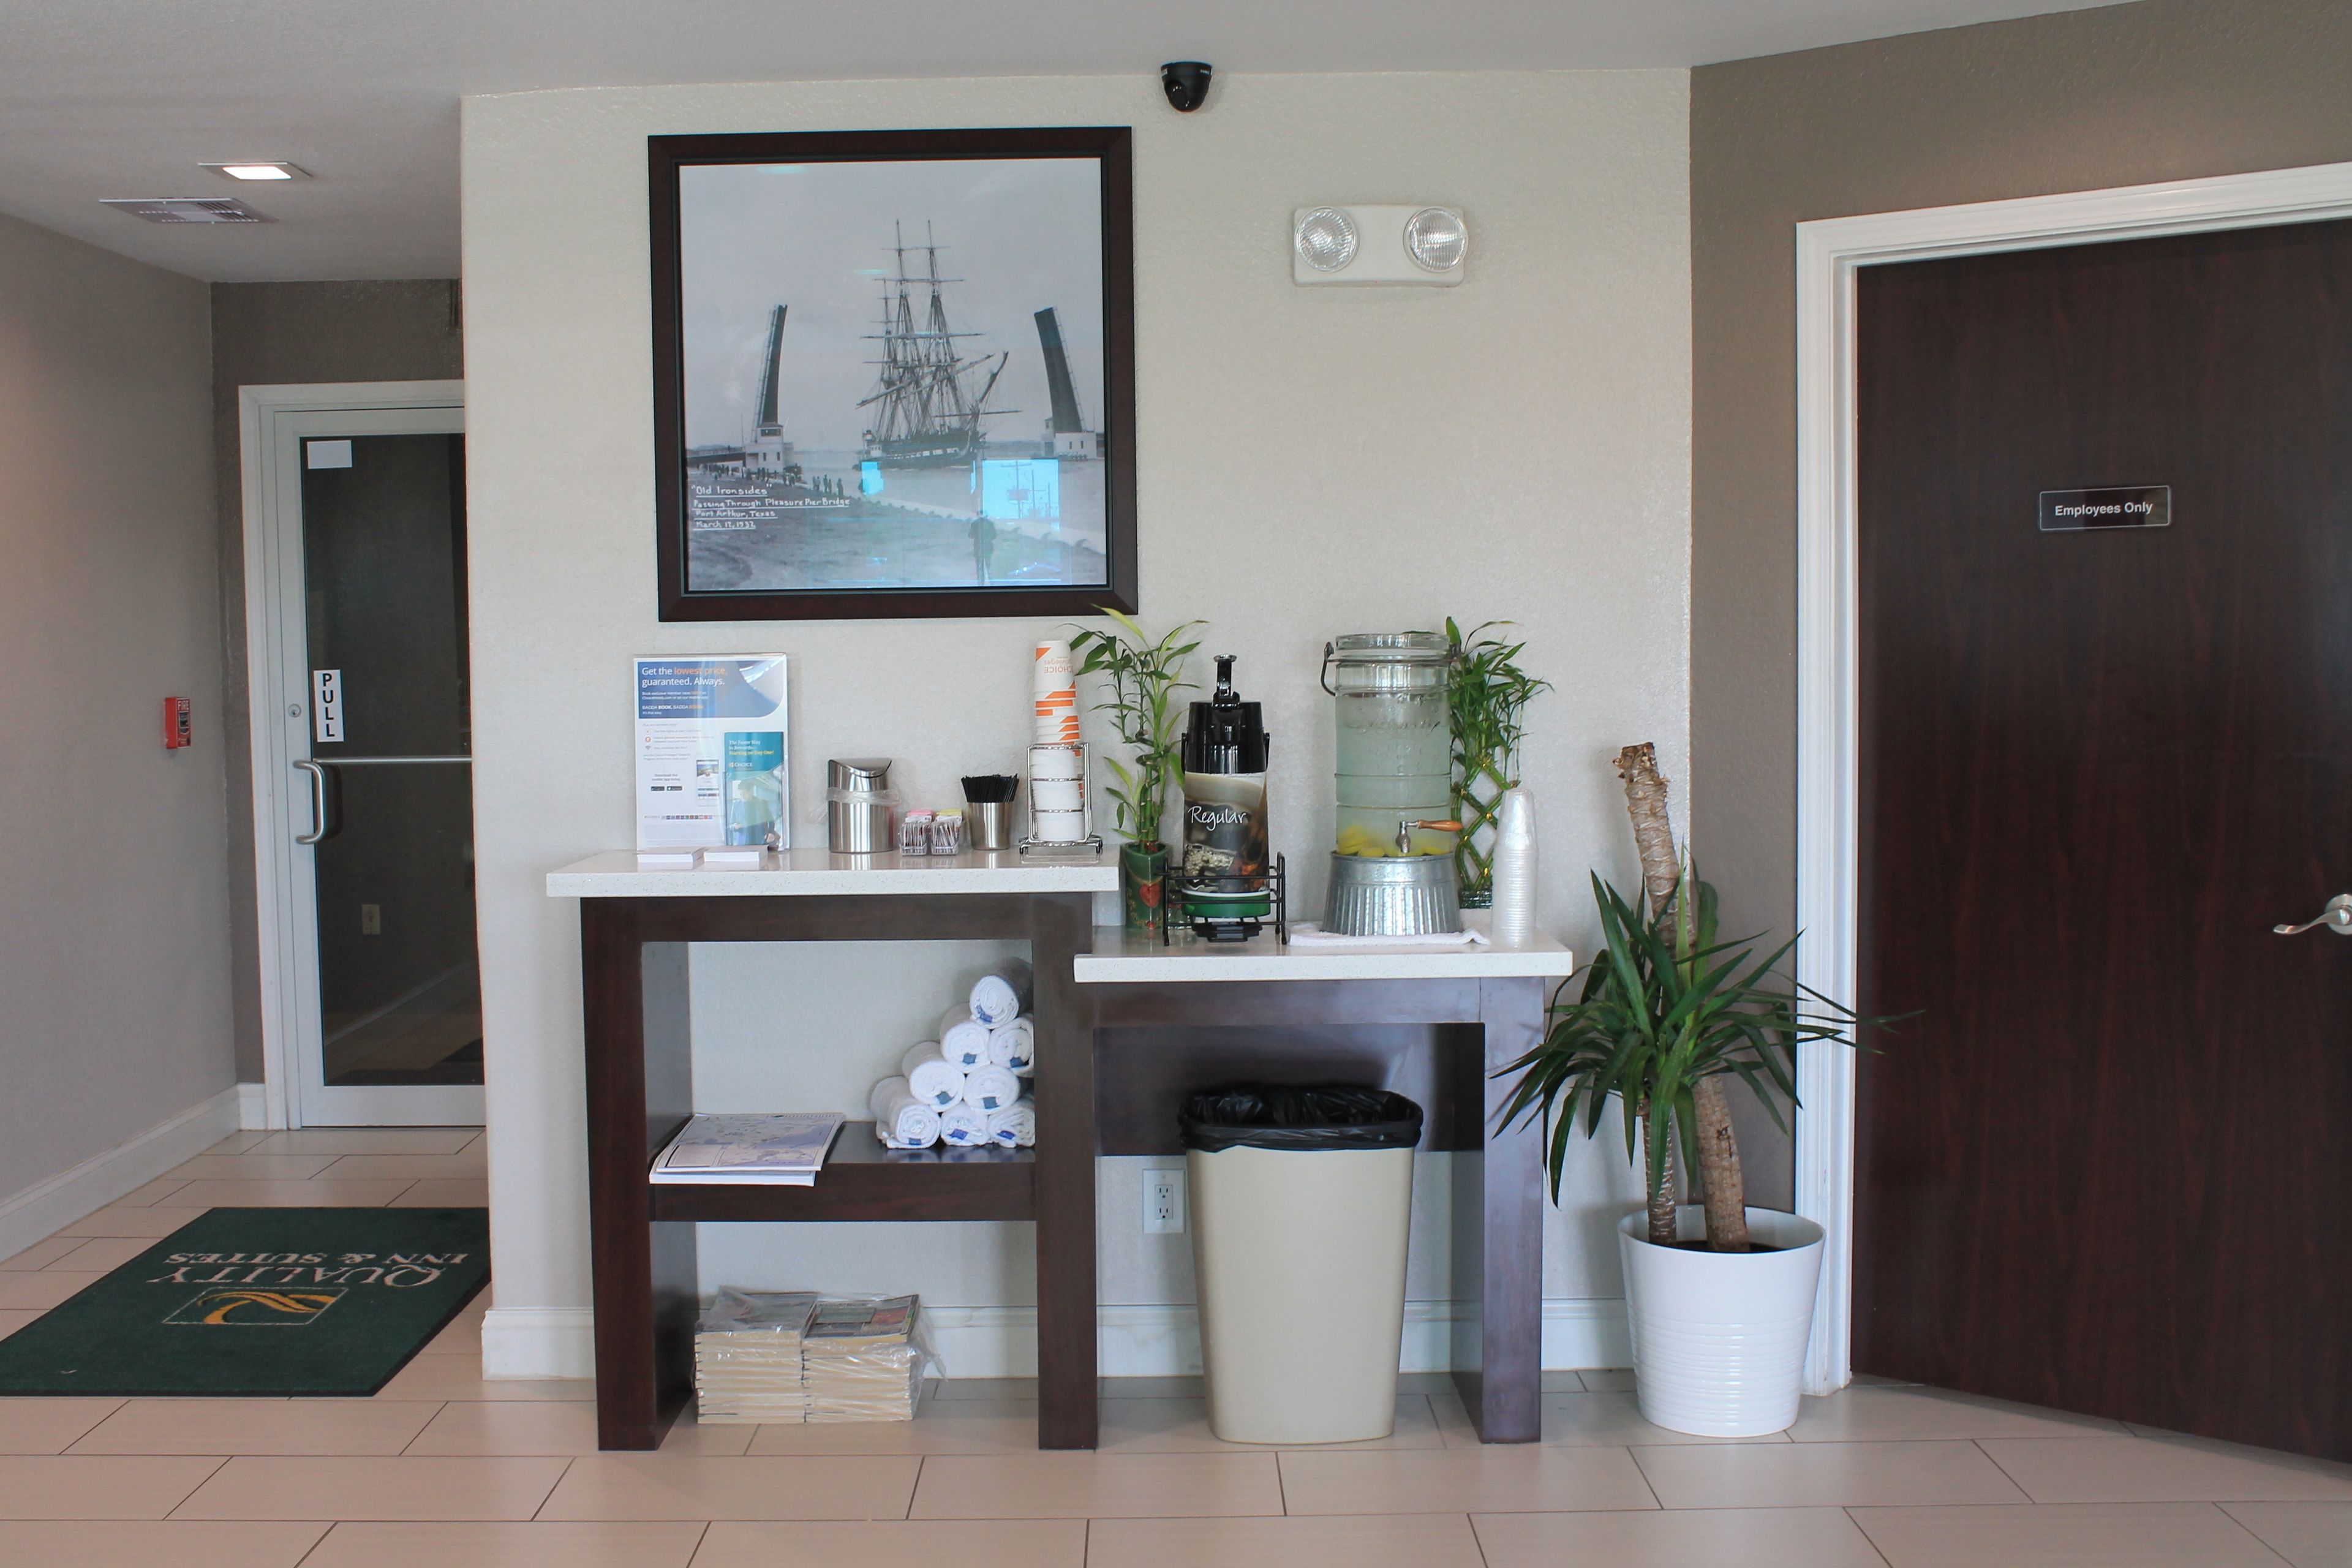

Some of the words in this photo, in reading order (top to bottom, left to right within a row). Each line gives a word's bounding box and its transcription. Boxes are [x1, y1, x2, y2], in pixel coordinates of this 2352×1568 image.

[717, 484, 772, 494] Ironsides"
[693, 499, 725, 509] Passing
[725, 499, 761, 508] Through
[822, 497, 850, 507] Bridge
[2055, 504, 2120, 518] Employees
[2124, 501, 2153, 514] Only
[642, 677, 692, 688] guaranteed.
[693, 677, 725, 687] Always.
[178, 700, 189, 710] FIRE
[322, 673, 335, 737] PULL
[1188, 805, 1246, 831] Regular
[163, 1253, 328, 1264] SUITES
[337, 1254, 377, 1264] &
[385, 1253, 469, 1264] INN
[146, 1264, 445, 1287] QUALITY
